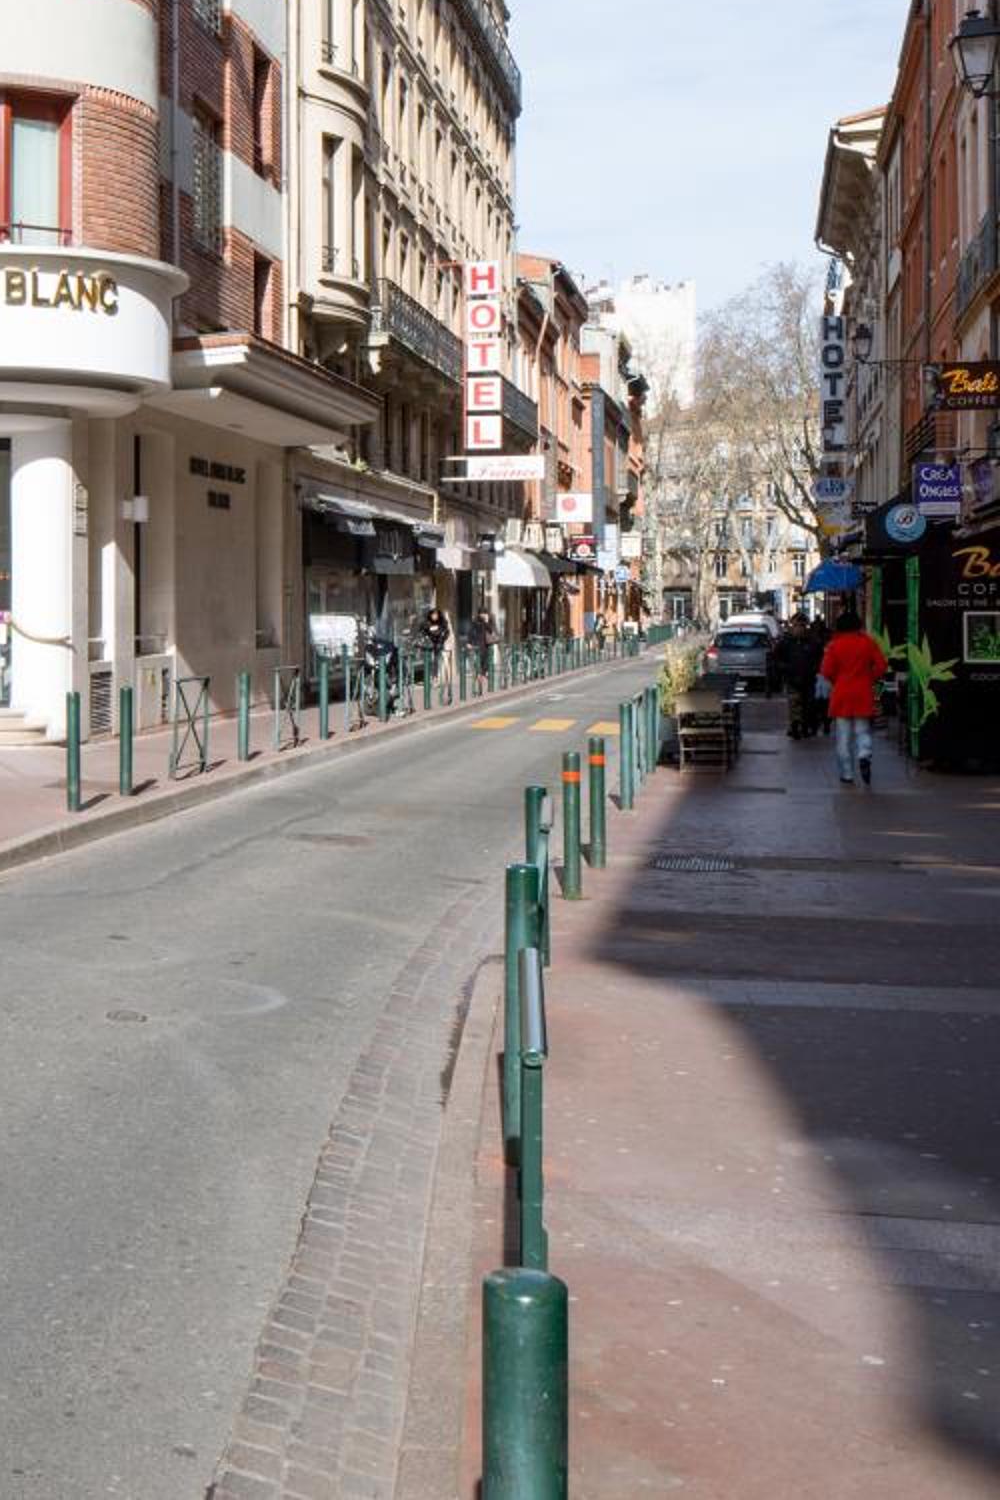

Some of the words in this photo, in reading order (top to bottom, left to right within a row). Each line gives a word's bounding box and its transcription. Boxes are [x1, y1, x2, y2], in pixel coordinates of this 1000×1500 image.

[4, 266, 120, 317] BLANC
[470, 265, 496, 445] HOTEL
[823, 316, 845, 451] HOTEL
